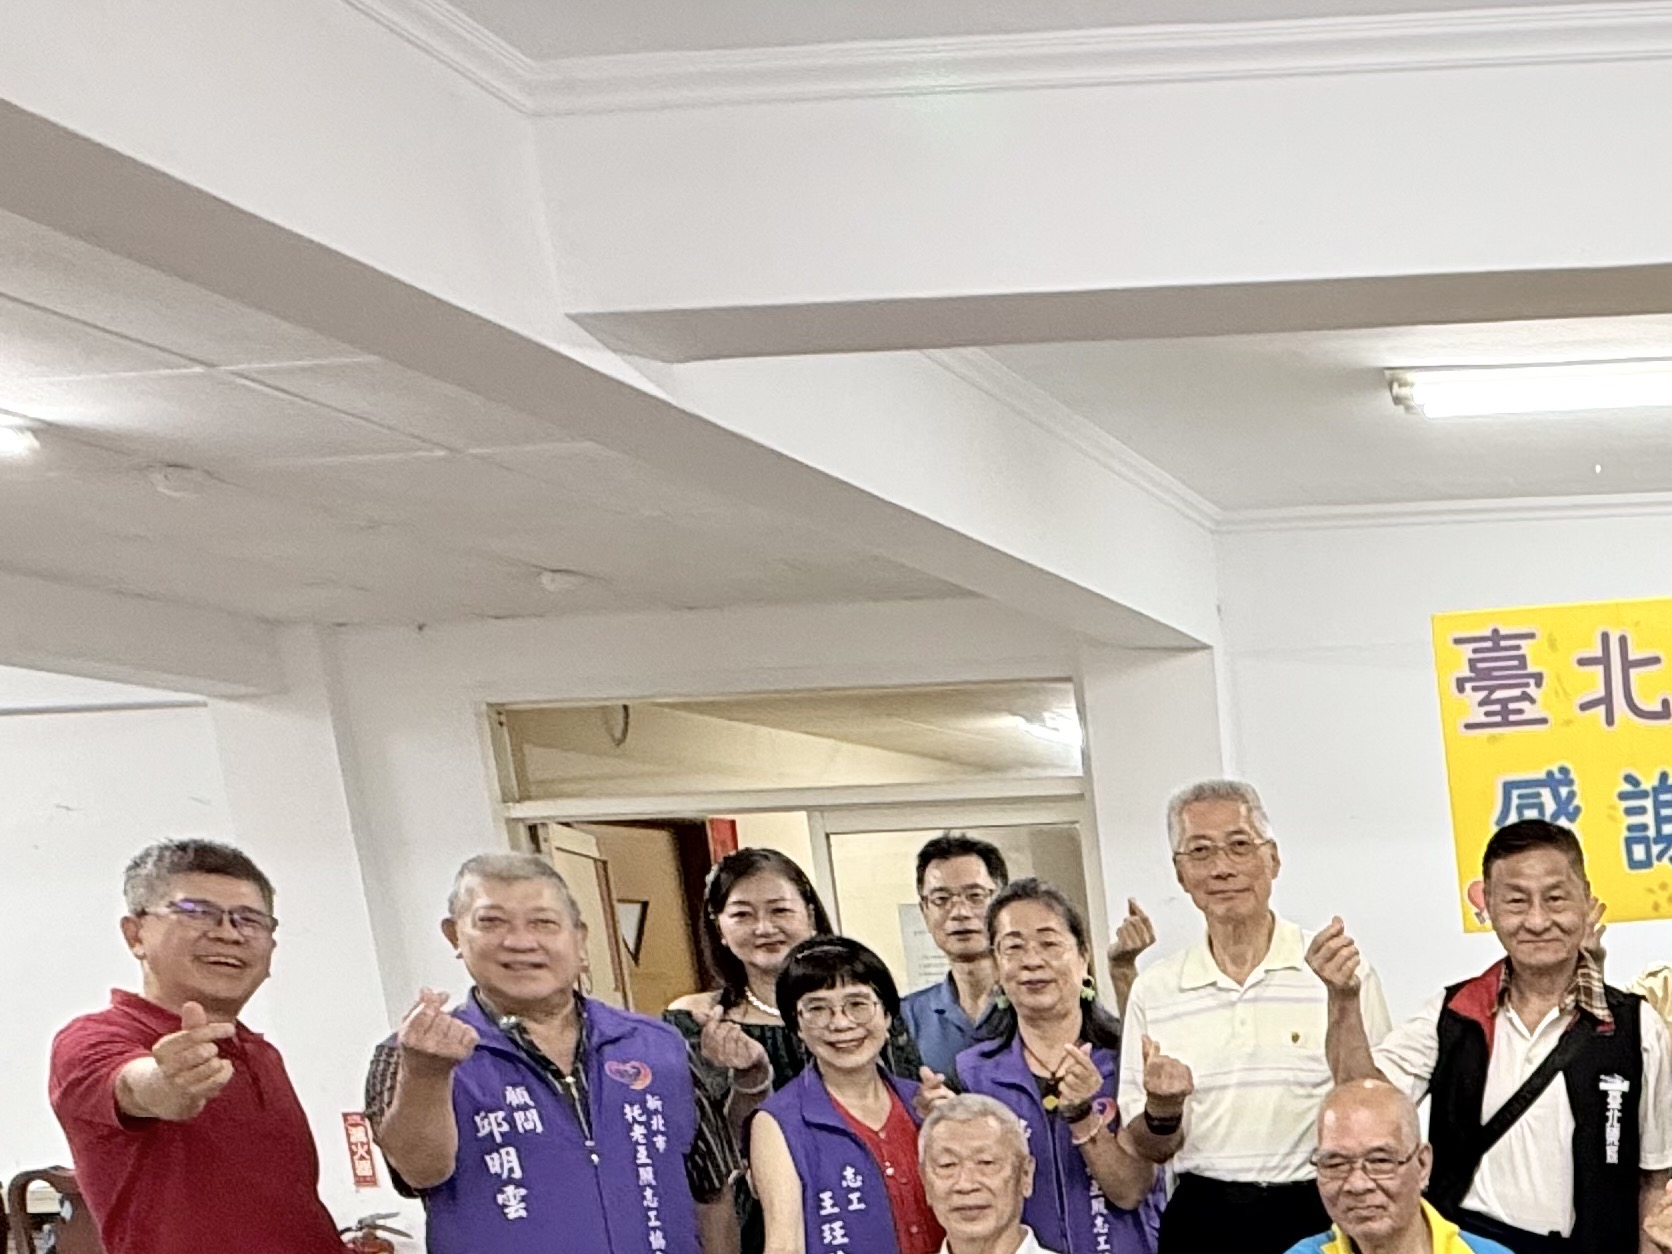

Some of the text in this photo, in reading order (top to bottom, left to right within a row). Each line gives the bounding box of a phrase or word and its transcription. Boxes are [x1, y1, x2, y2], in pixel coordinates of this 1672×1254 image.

[504, 1085, 543, 1134] 顧問
[646, 1093, 667, 1153] 新北市
[473, 1110, 529, 1220] 邱明雲
[841, 1164, 867, 1211] 志工
